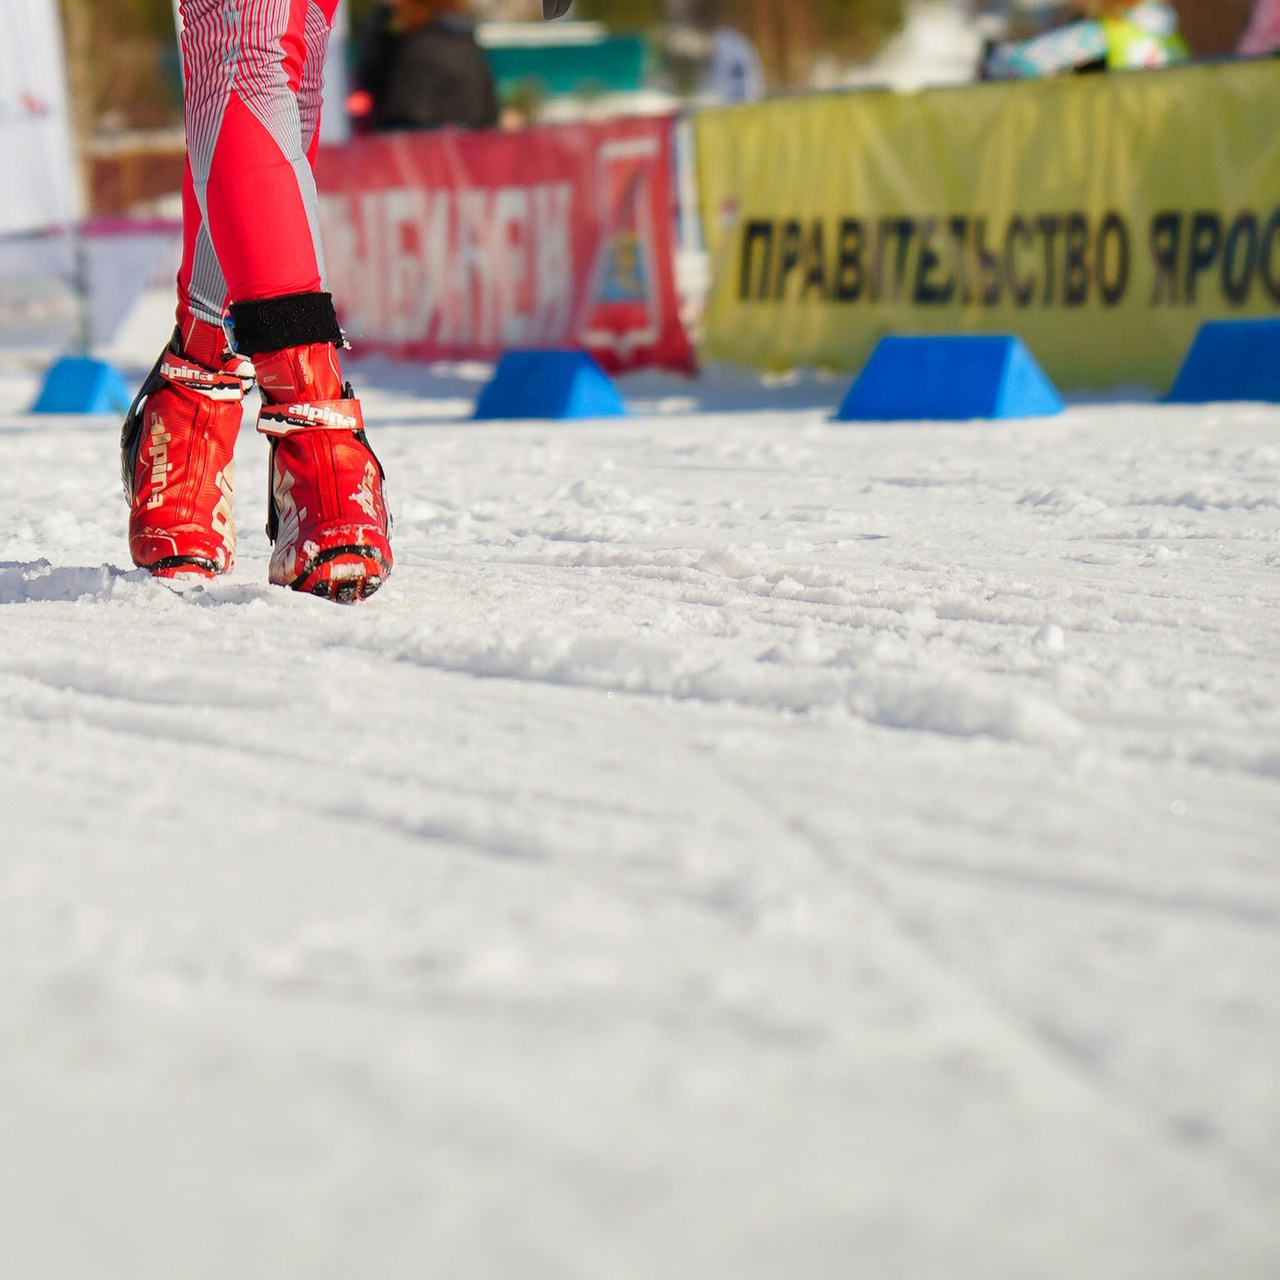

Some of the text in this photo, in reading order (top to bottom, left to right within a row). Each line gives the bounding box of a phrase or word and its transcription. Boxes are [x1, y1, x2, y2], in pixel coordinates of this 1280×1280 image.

[740, 210, 1131, 307] ПРАВИТЕЛЬСТВО
[147, 411, 173, 511] alpina
[288, 403, 357, 428] alpina
